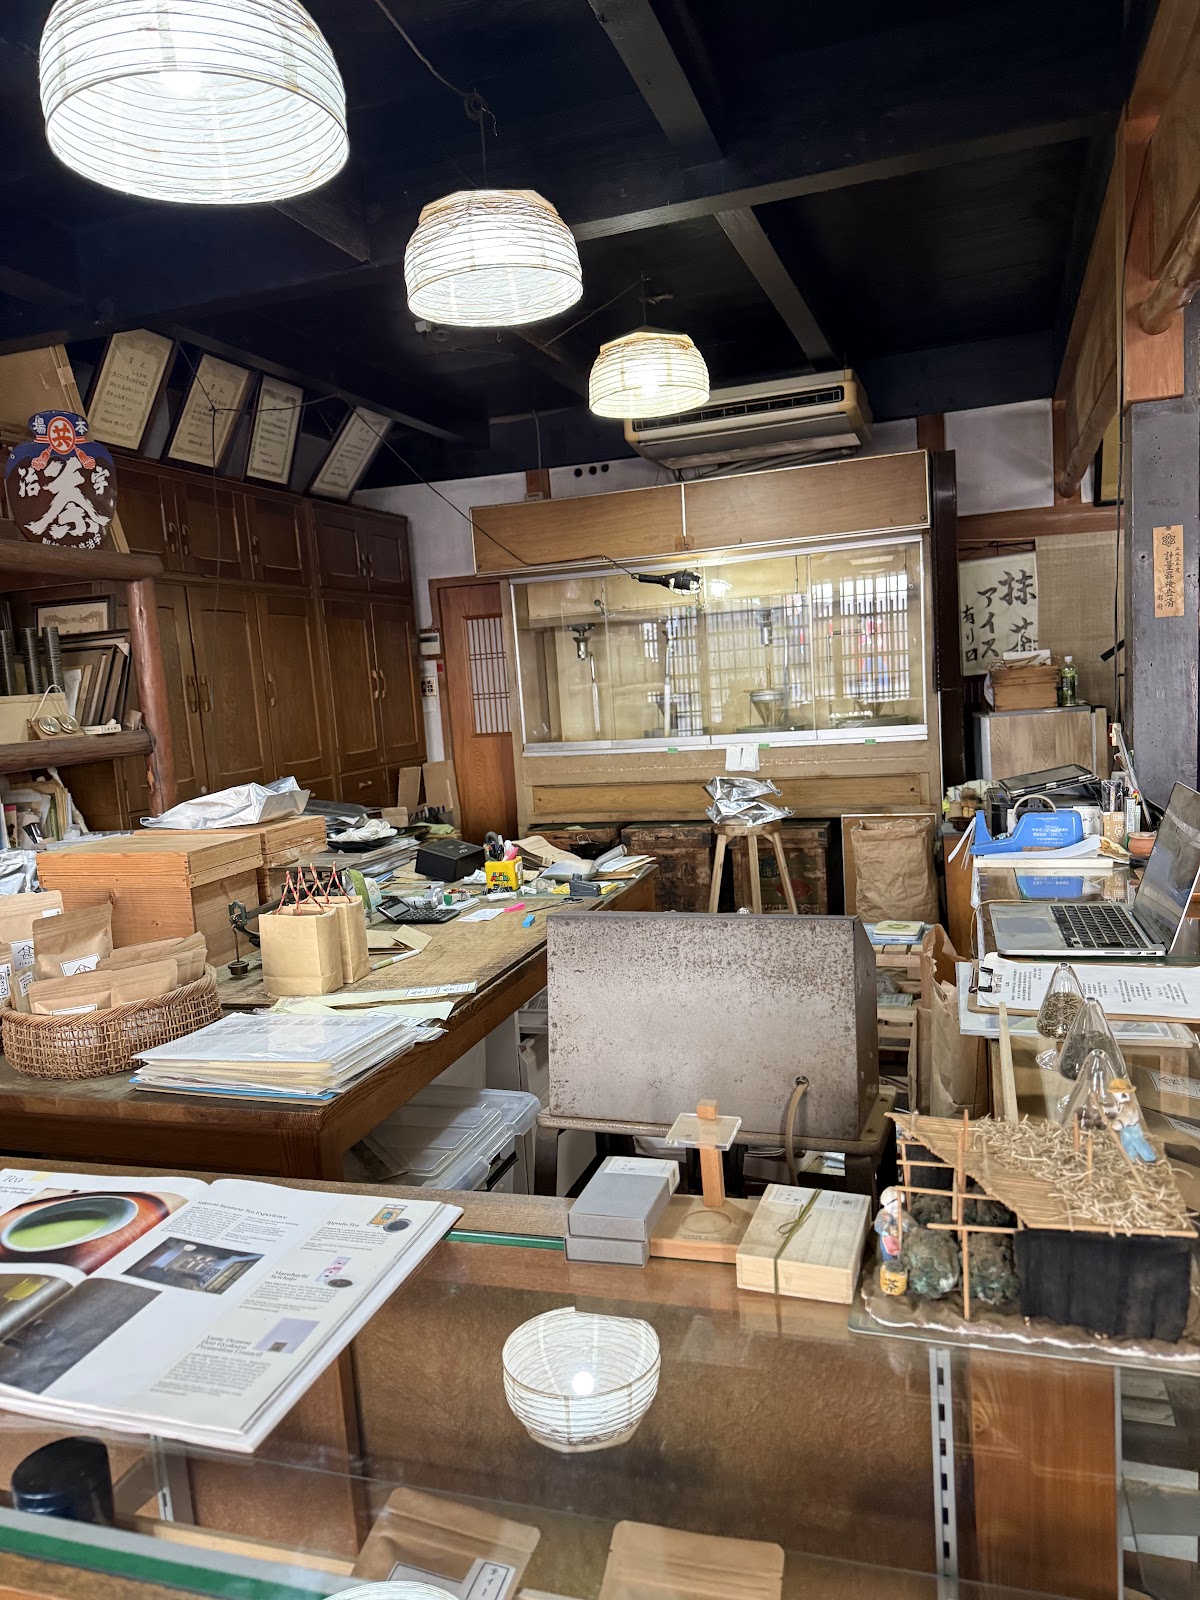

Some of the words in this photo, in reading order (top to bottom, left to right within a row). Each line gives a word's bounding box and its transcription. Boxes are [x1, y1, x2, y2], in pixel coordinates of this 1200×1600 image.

[977, 587, 999, 659] アイス
[998, 569, 1038, 652] 抹茶
[255, 1210, 288, 1219] Experience
